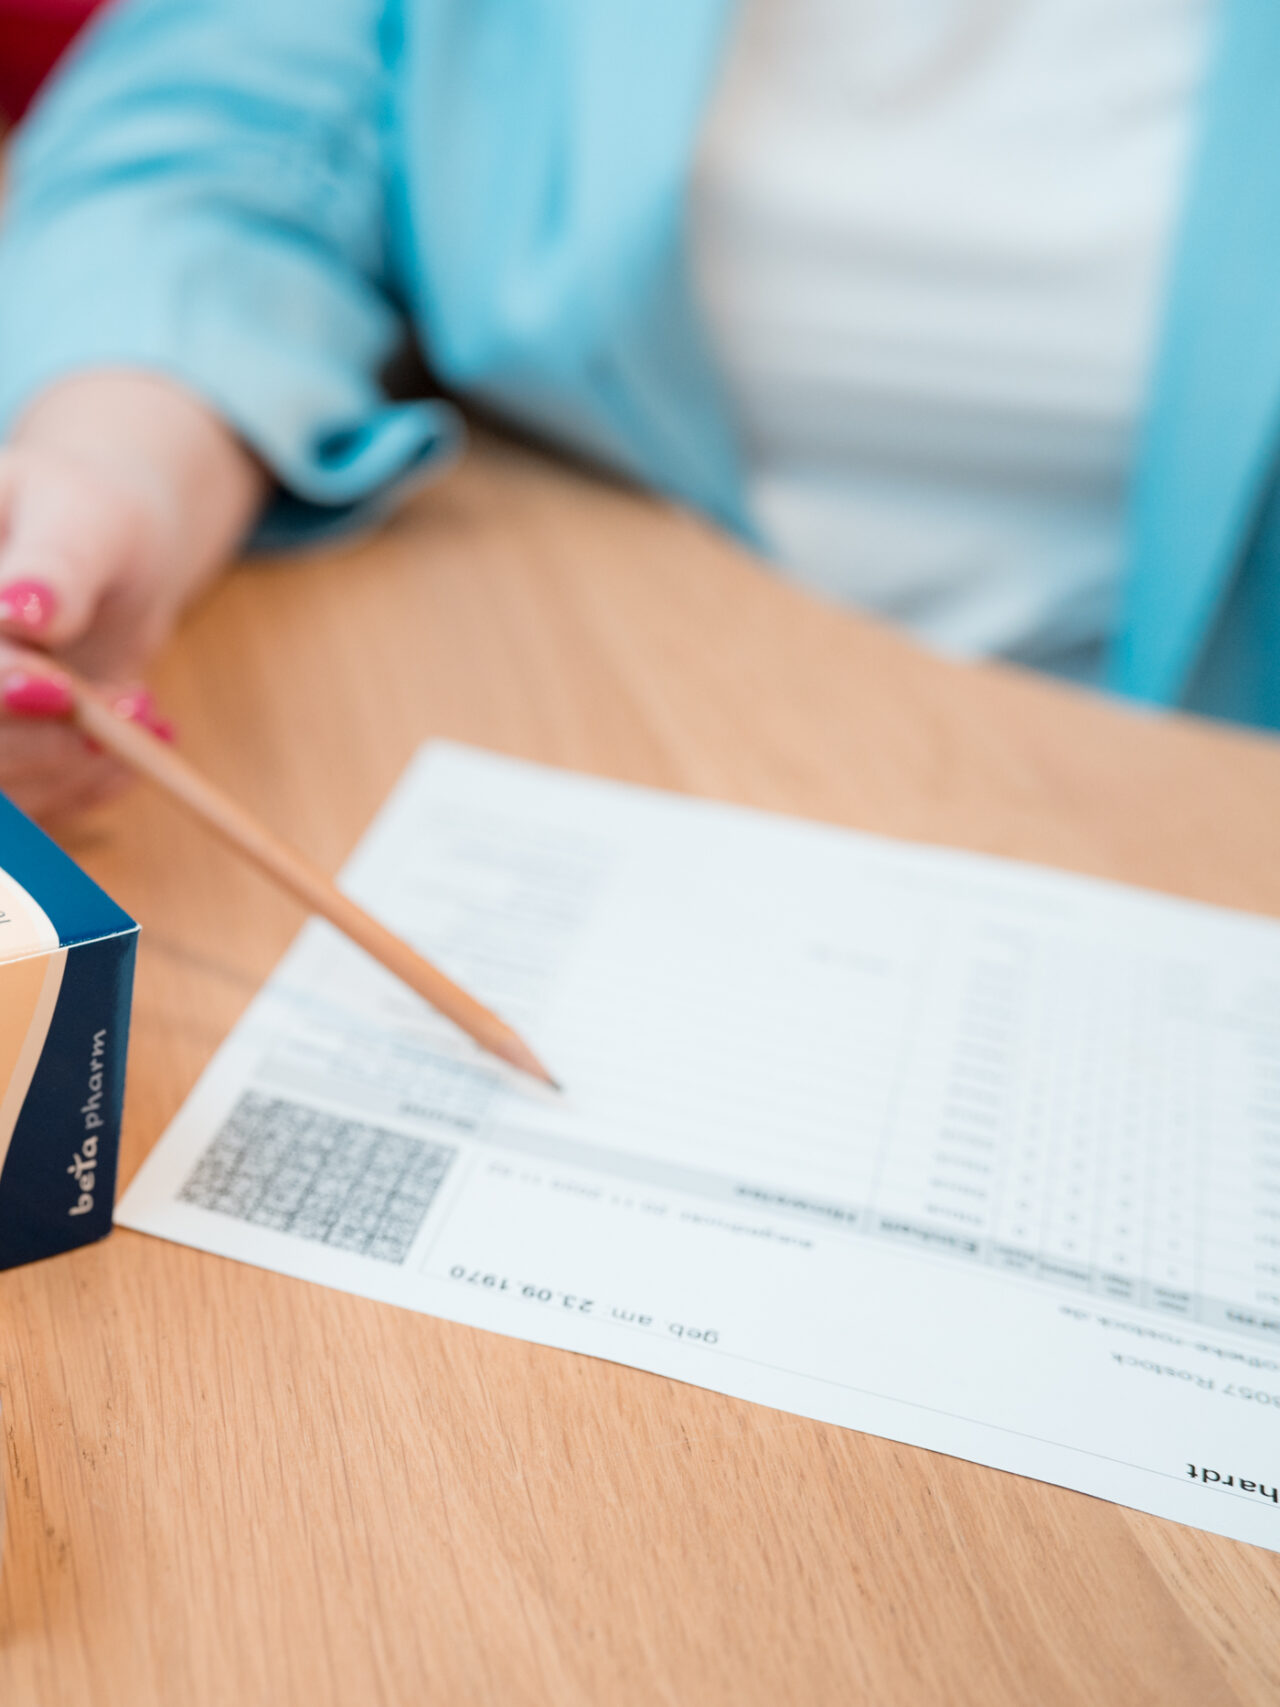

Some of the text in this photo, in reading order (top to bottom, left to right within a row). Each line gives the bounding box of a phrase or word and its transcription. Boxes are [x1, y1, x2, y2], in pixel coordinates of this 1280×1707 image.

[67, 1029, 107, 1216] beta pharm
[449, 1264, 596, 1314] 23.09.1970
